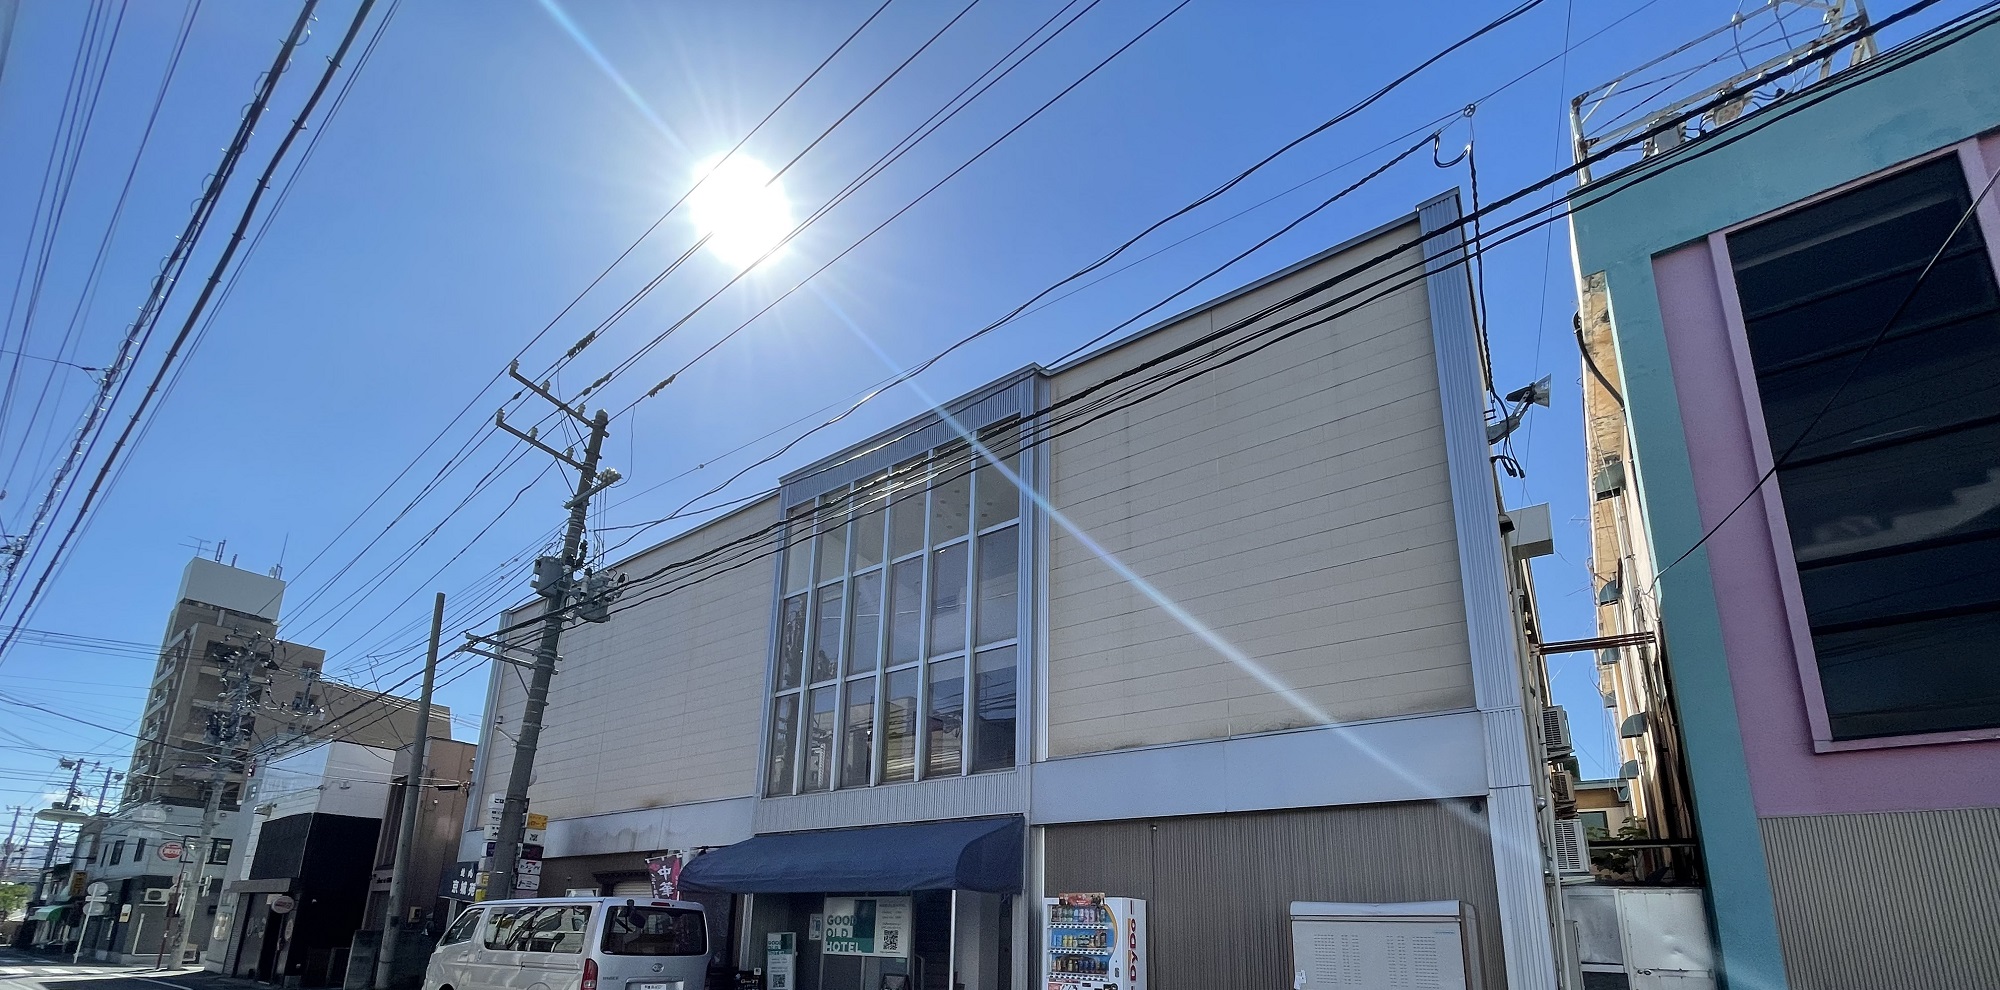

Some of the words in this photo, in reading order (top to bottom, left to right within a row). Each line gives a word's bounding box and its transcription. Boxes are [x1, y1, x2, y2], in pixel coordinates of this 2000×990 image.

[657, 865, 675, 898] 中華
[826, 914, 857, 926] GOOD
[826, 928, 849, 938] OLD
[825, 941, 862, 953] HOTEL
